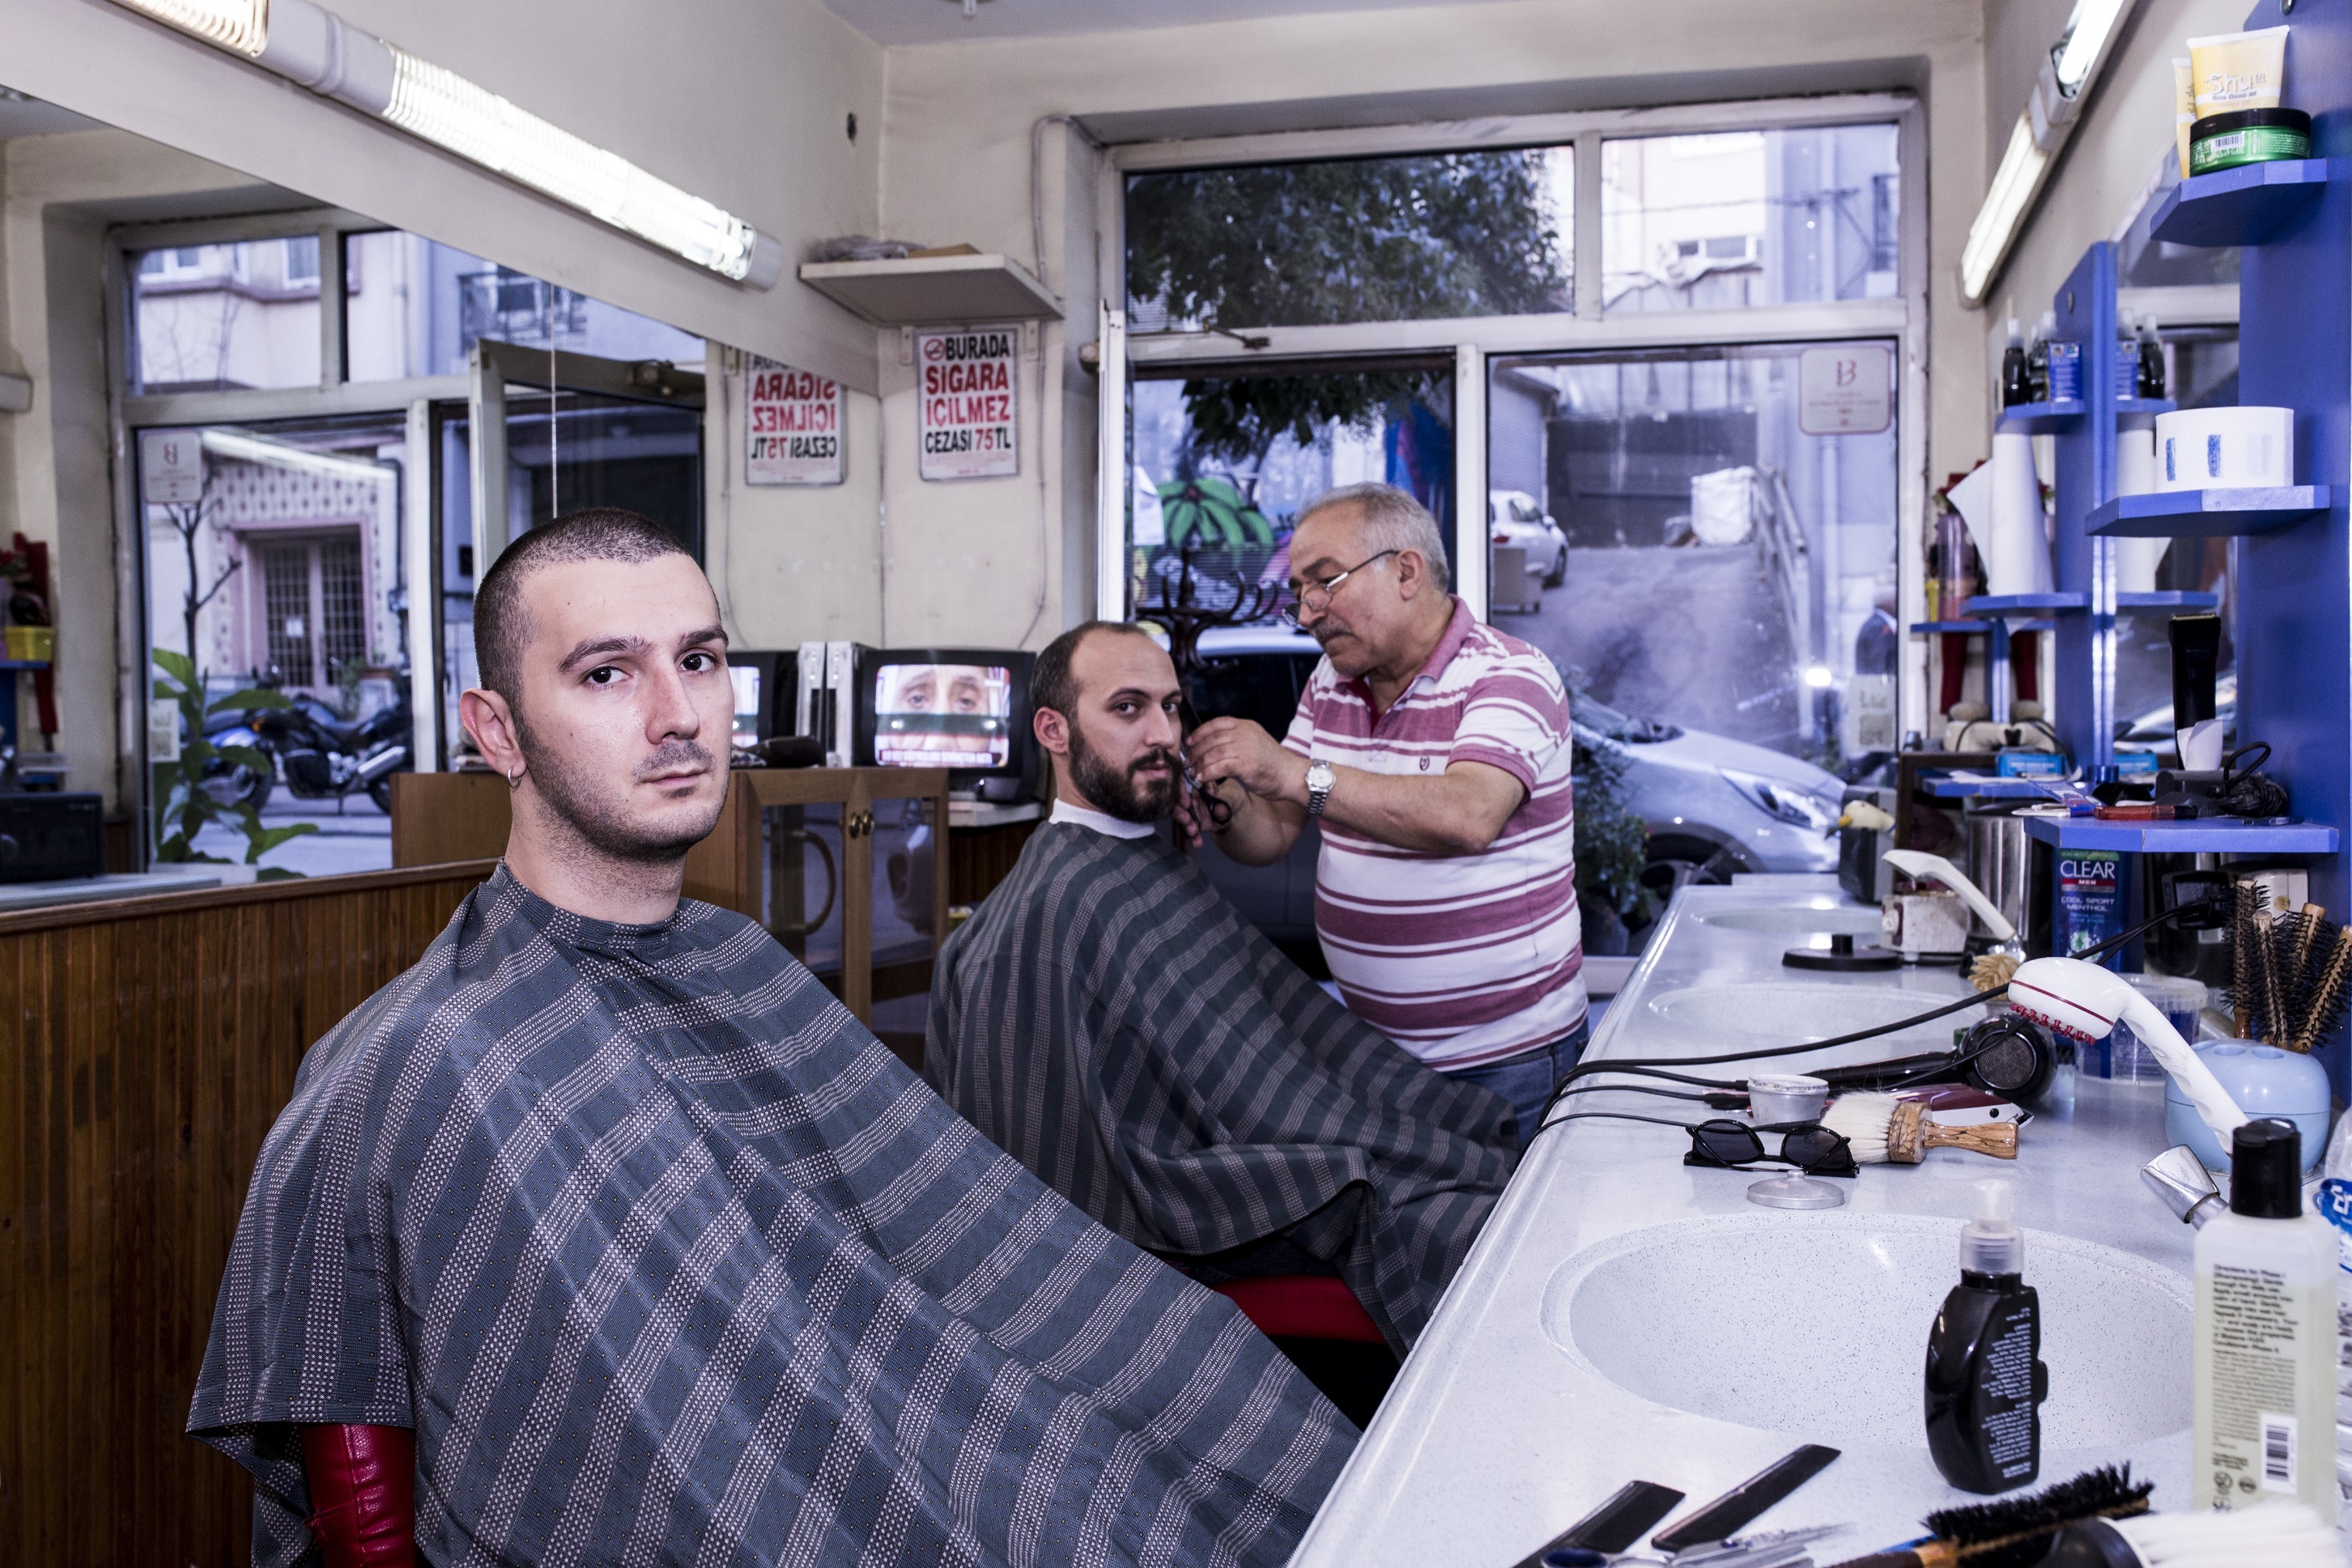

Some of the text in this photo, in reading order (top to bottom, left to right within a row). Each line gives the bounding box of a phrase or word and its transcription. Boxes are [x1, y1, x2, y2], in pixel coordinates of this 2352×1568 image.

[946, 334, 1010, 361] BURADA
[925, 430, 972, 453] CEZASI
[2060, 859, 2115, 879] CLEAR
[2061, 896, 2083, 904] COOL
[2066, 904, 2108, 912] MENTHOL
